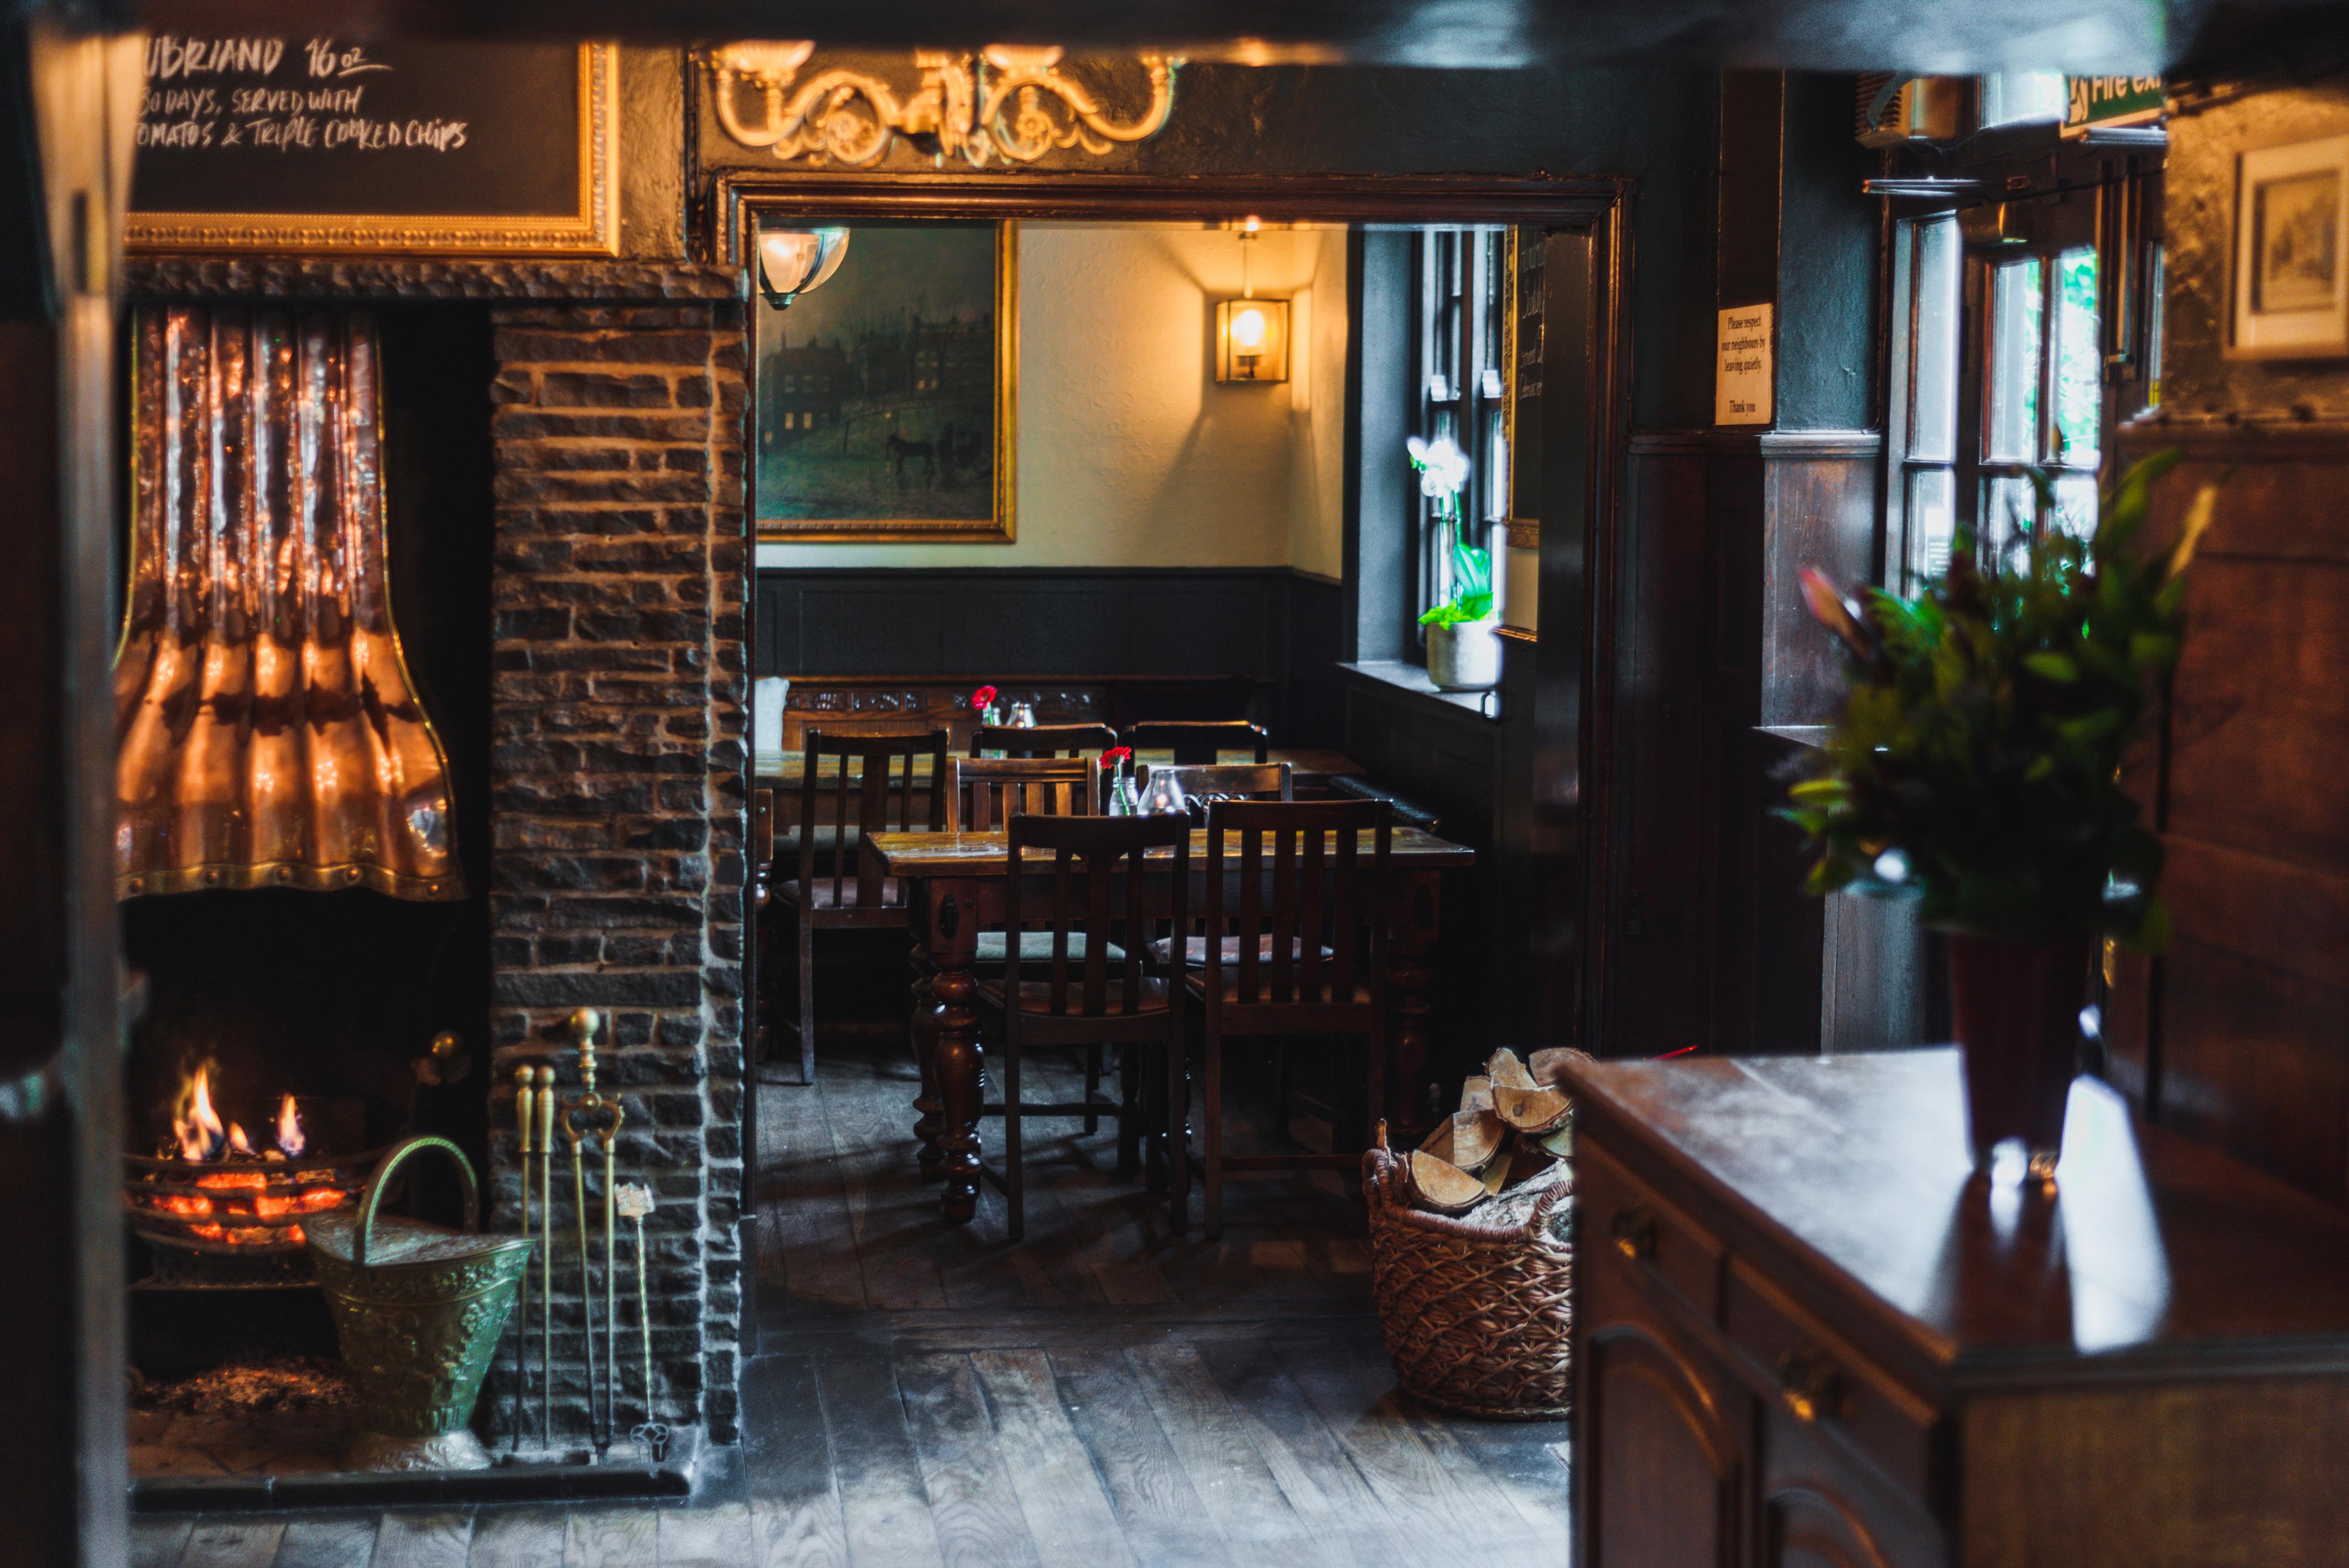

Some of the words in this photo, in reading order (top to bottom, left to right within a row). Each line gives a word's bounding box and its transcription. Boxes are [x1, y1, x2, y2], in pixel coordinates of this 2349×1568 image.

[232, 87, 305, 117] SERVED
[308, 85, 365, 114] WITH
[221, 122, 242, 147] &
[245, 116, 320, 153] TRIPLE
[324, 118, 402, 151] COOKED
[1727, 316, 1743, 330] Please
[1744, 315, 1761, 332] respect
[1721, 342, 1730, 352] our
[1730, 336, 1759, 355] neighbours
[1759, 335, 1765, 353] by
[1724, 358, 1743, 376] leaving
[1729, 399, 1745, 414] Thank
[1745, 402, 1756, 416] you
